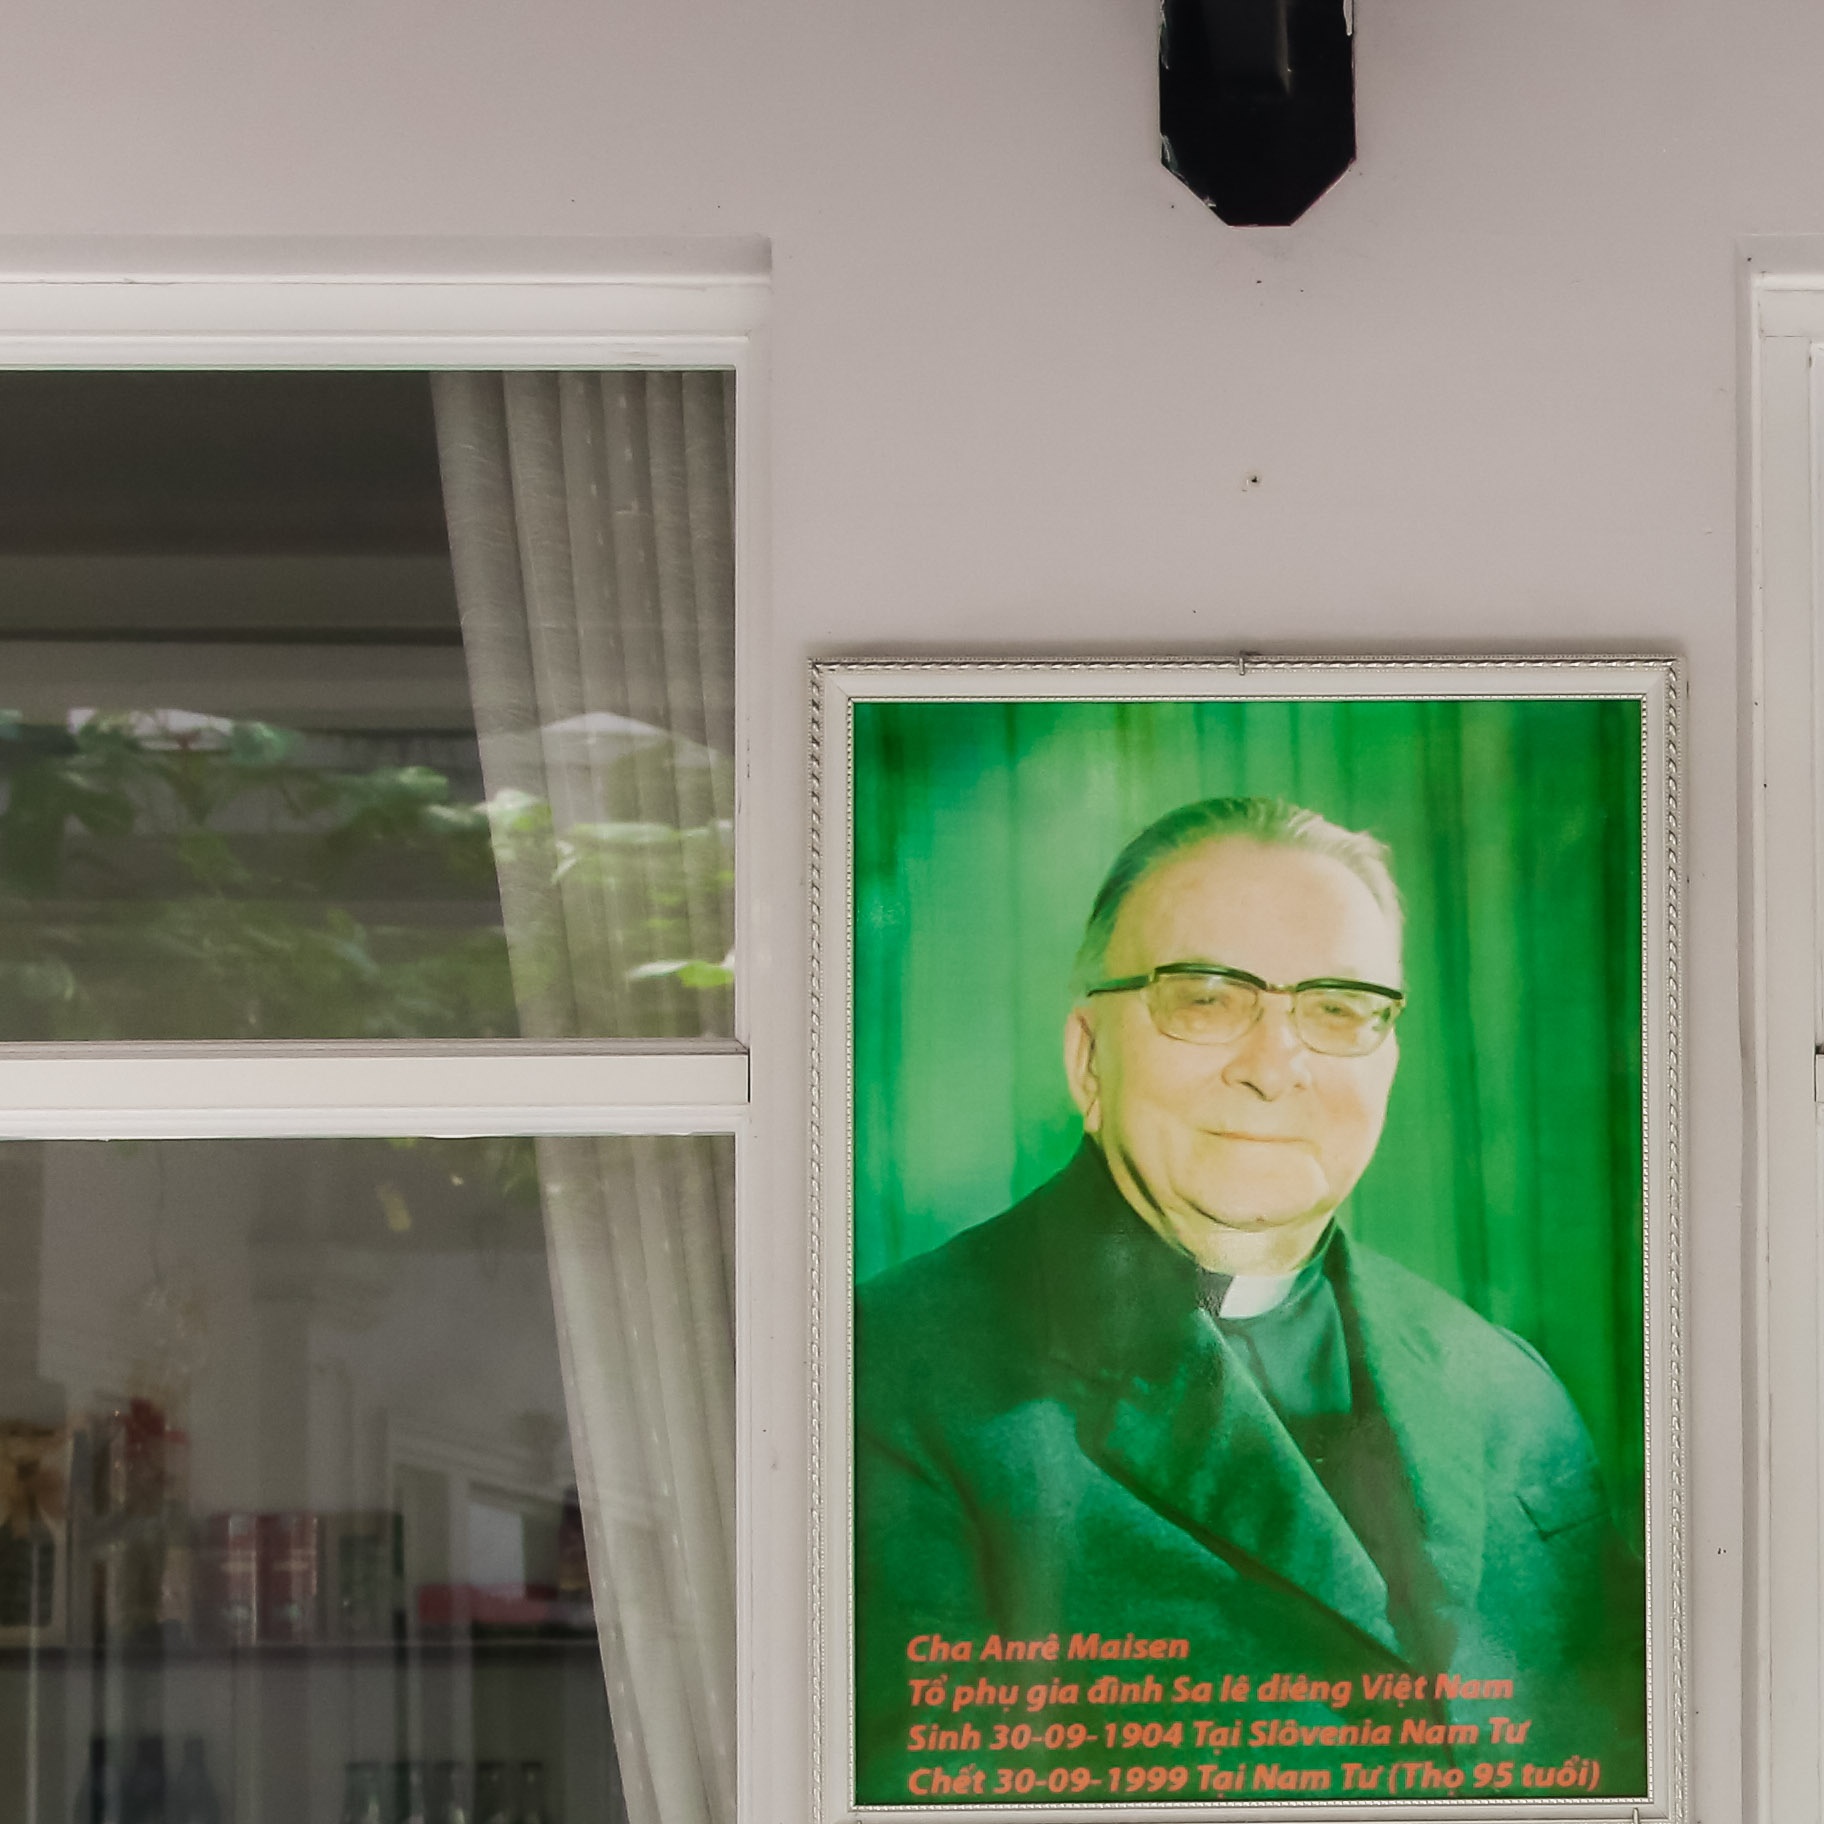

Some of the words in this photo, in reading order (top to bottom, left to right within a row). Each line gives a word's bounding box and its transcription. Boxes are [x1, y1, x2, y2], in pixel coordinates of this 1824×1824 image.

[907, 1634, 973, 1662] Cha
[1068, 1633, 1189, 1660] Maisen
[908, 1674, 949, 1706] Tổ
[952, 1677, 1020, 1713] phụ
[1026, 1677, 1080, 1712] gia
[1087, 1675, 1164, 1703] đình
[1171, 1676, 1213, 1703] Sa
[1220, 1675, 1250, 1702] lê
[1257, 1673, 1353, 1709] diêng
[1362, 1673, 1428, 1707] Việt
[1433, 1672, 1513, 1701] Nam
[907, 1723, 982, 1751] Sinh
[1193, 1720, 1243, 1755] Tại
[1400, 1718, 1479, 1745] Nam
[1489, 1716, 1532, 1744] Tư
[908, 1763, 987, 1795] Chết
[1197, 1764, 1246, 1799] Tại
[1253, 1764, 1331, 1791] Nam
[1342, 1762, 1385, 1790] Tư
[1388, 1762, 1466, 1796] (Thọ
[1473, 1762, 1515, 1788] 95
[1521, 1755, 1600, 1792] tuổi)
